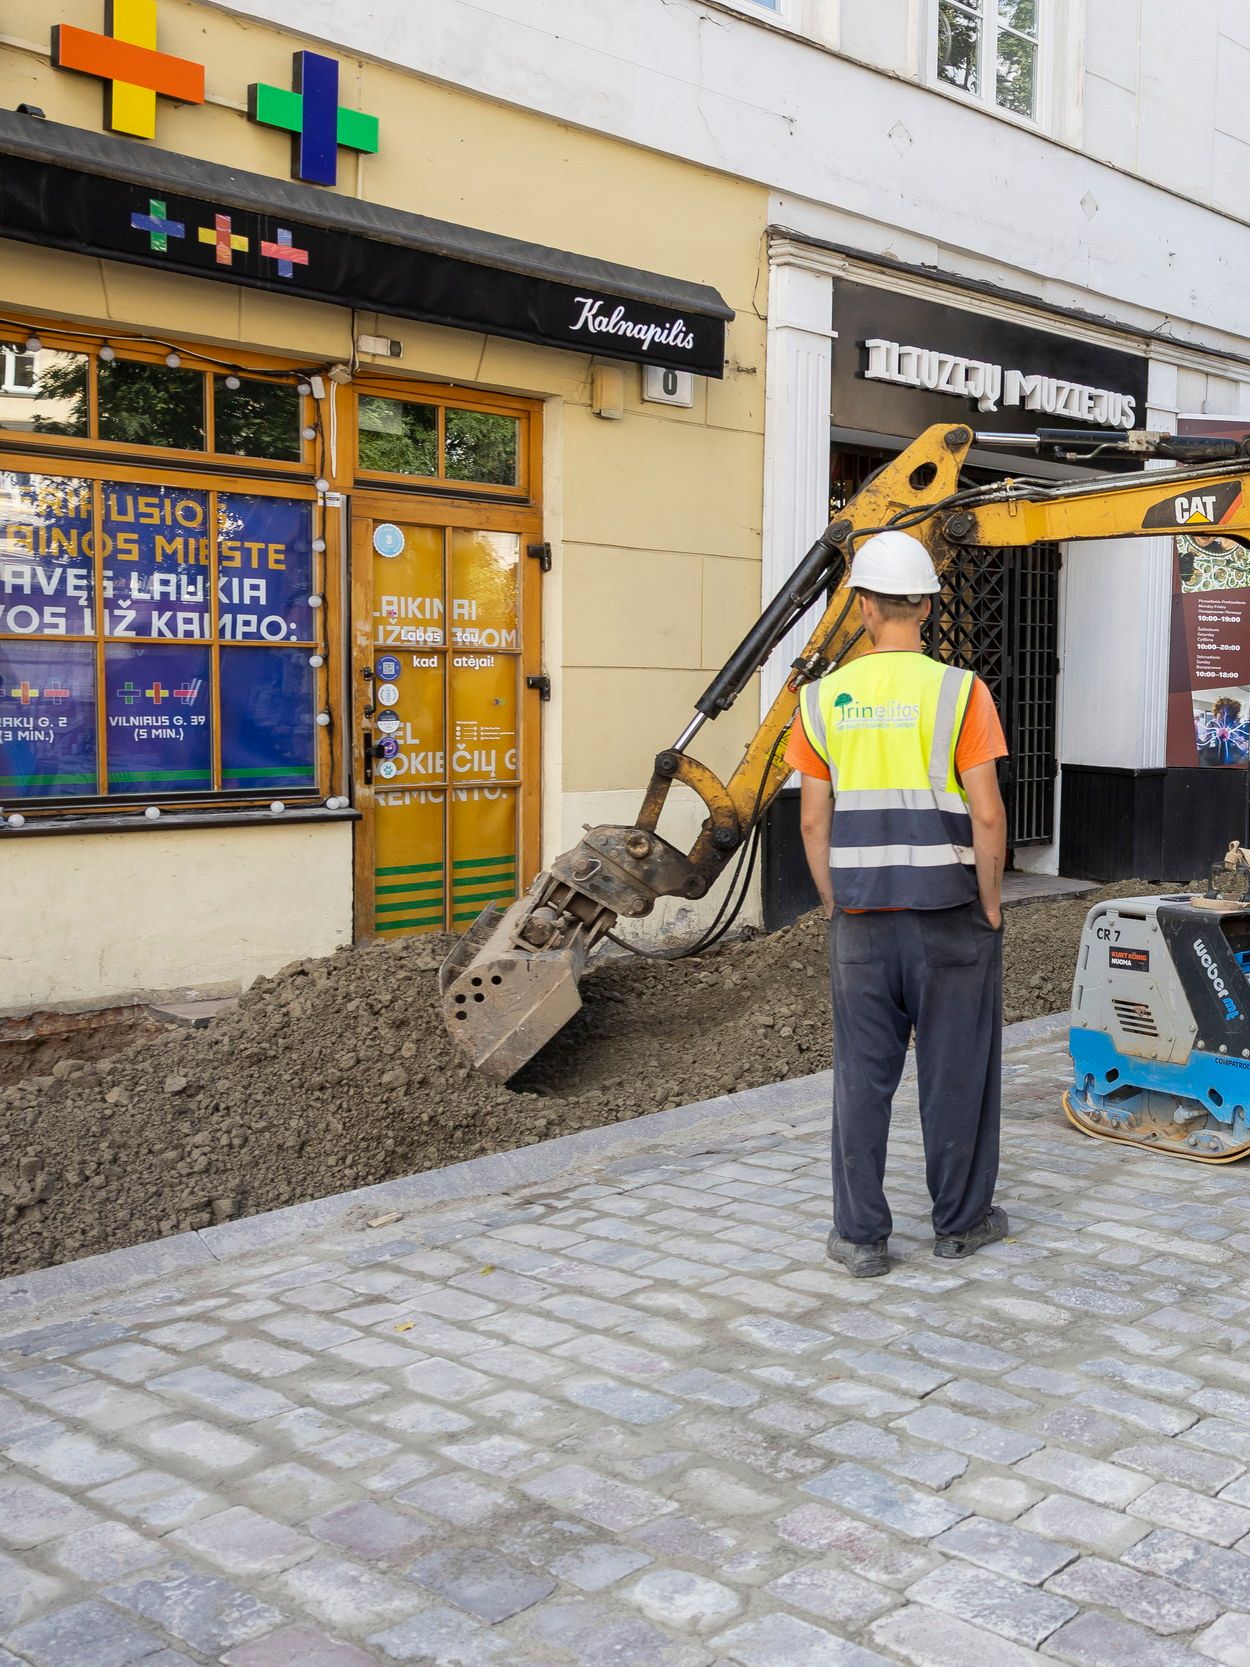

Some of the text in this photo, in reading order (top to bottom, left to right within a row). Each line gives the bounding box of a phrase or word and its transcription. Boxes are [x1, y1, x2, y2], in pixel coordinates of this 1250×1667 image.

[569, 297, 694, 350] Kalnapilis
[864, 339, 1136, 430] ILIUZIJŲ MUZIEJUS
[1175, 496, 1216, 524] CAT
[6, 524, 287, 570] AINOS MIESTE
[3, 564, 267, 606] AVĘS LAUKIA
[373, 596, 477, 620] AIKINAI
[84, 600, 137, 637] UŽ
[152, 611, 298, 641] KAMPO:
[401, 629, 482, 644] Labas tau,
[413, 655, 494, 669] kad atėjai!
[38, 717, 54, 727] G.
[59, 717, 67, 727] 2
[109, 715, 206, 726] VILNIAUS G. 39
[18, 730, 54, 743] MIN.)
[133, 728, 184, 741] (5 MIN.)
[374, 743, 496, 777] OKIEČIŲ
[1096, 927, 1121, 942] CR 7
[1111, 951, 1147, 961] KURT KÖNIG
[1111, 958, 1132, 966] NUOMA
[1193, 939, 1229, 998] weber
